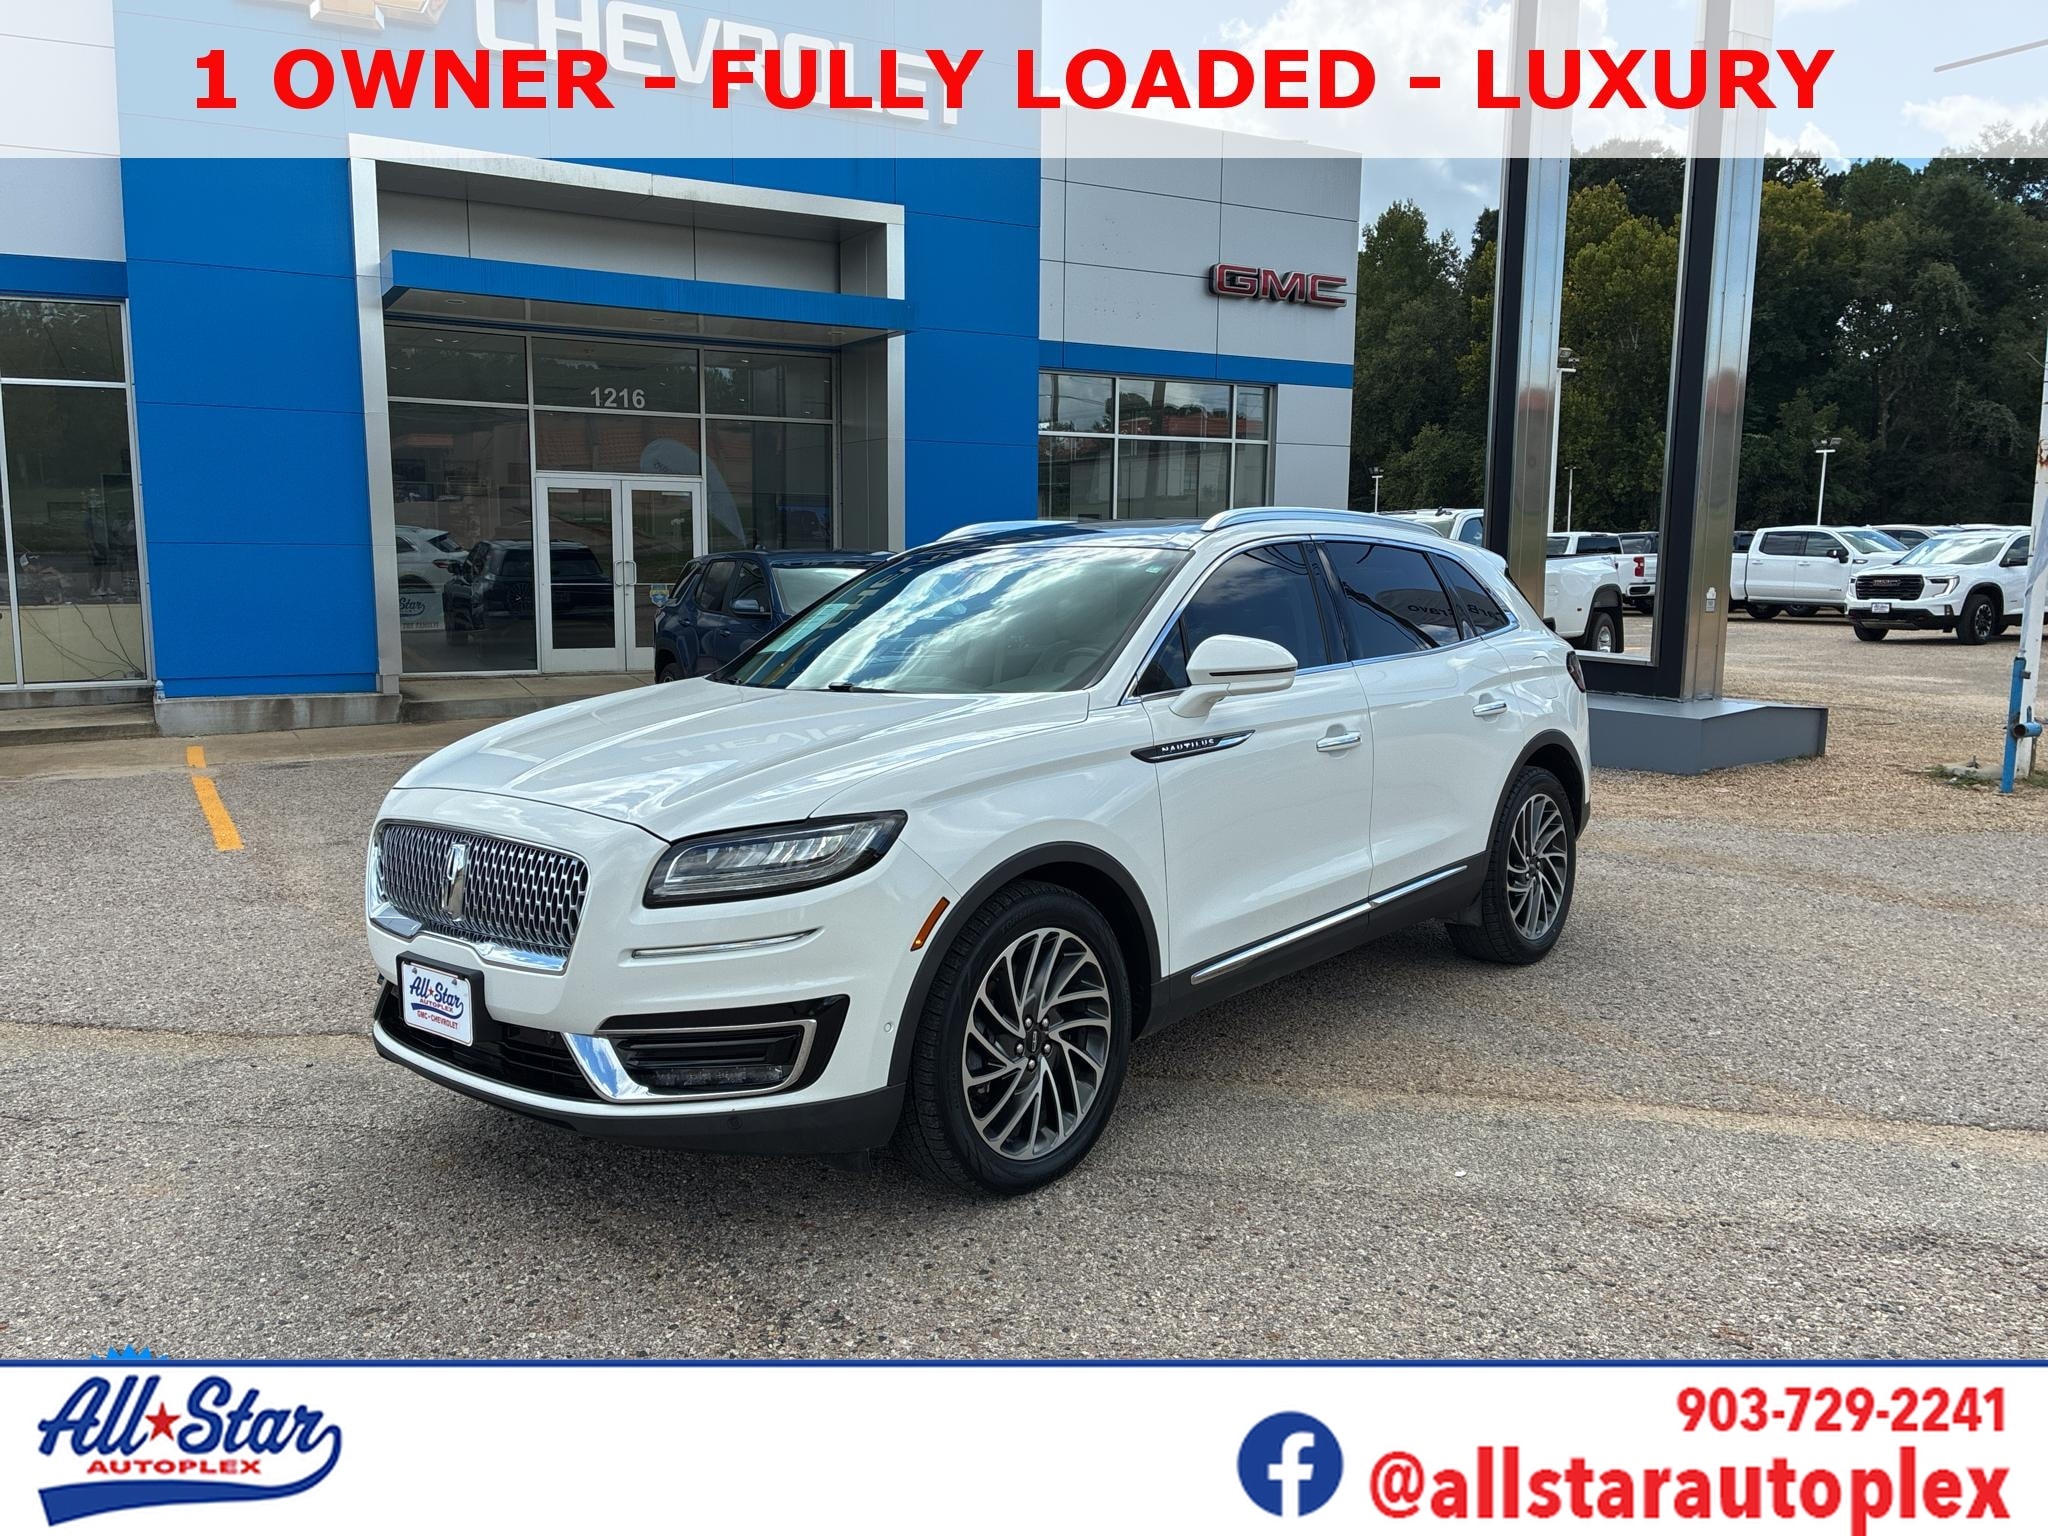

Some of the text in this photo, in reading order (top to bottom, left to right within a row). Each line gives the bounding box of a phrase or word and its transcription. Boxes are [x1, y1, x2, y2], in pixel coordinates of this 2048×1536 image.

[1210, 264, 1347, 307] GMC
[590, 387, 645, 409] 1216
[1161, 738, 1215, 752] NAUTILUS
[409, 976, 464, 1009] All Star
[420, 998, 454, 1013] AUTOPLEX
